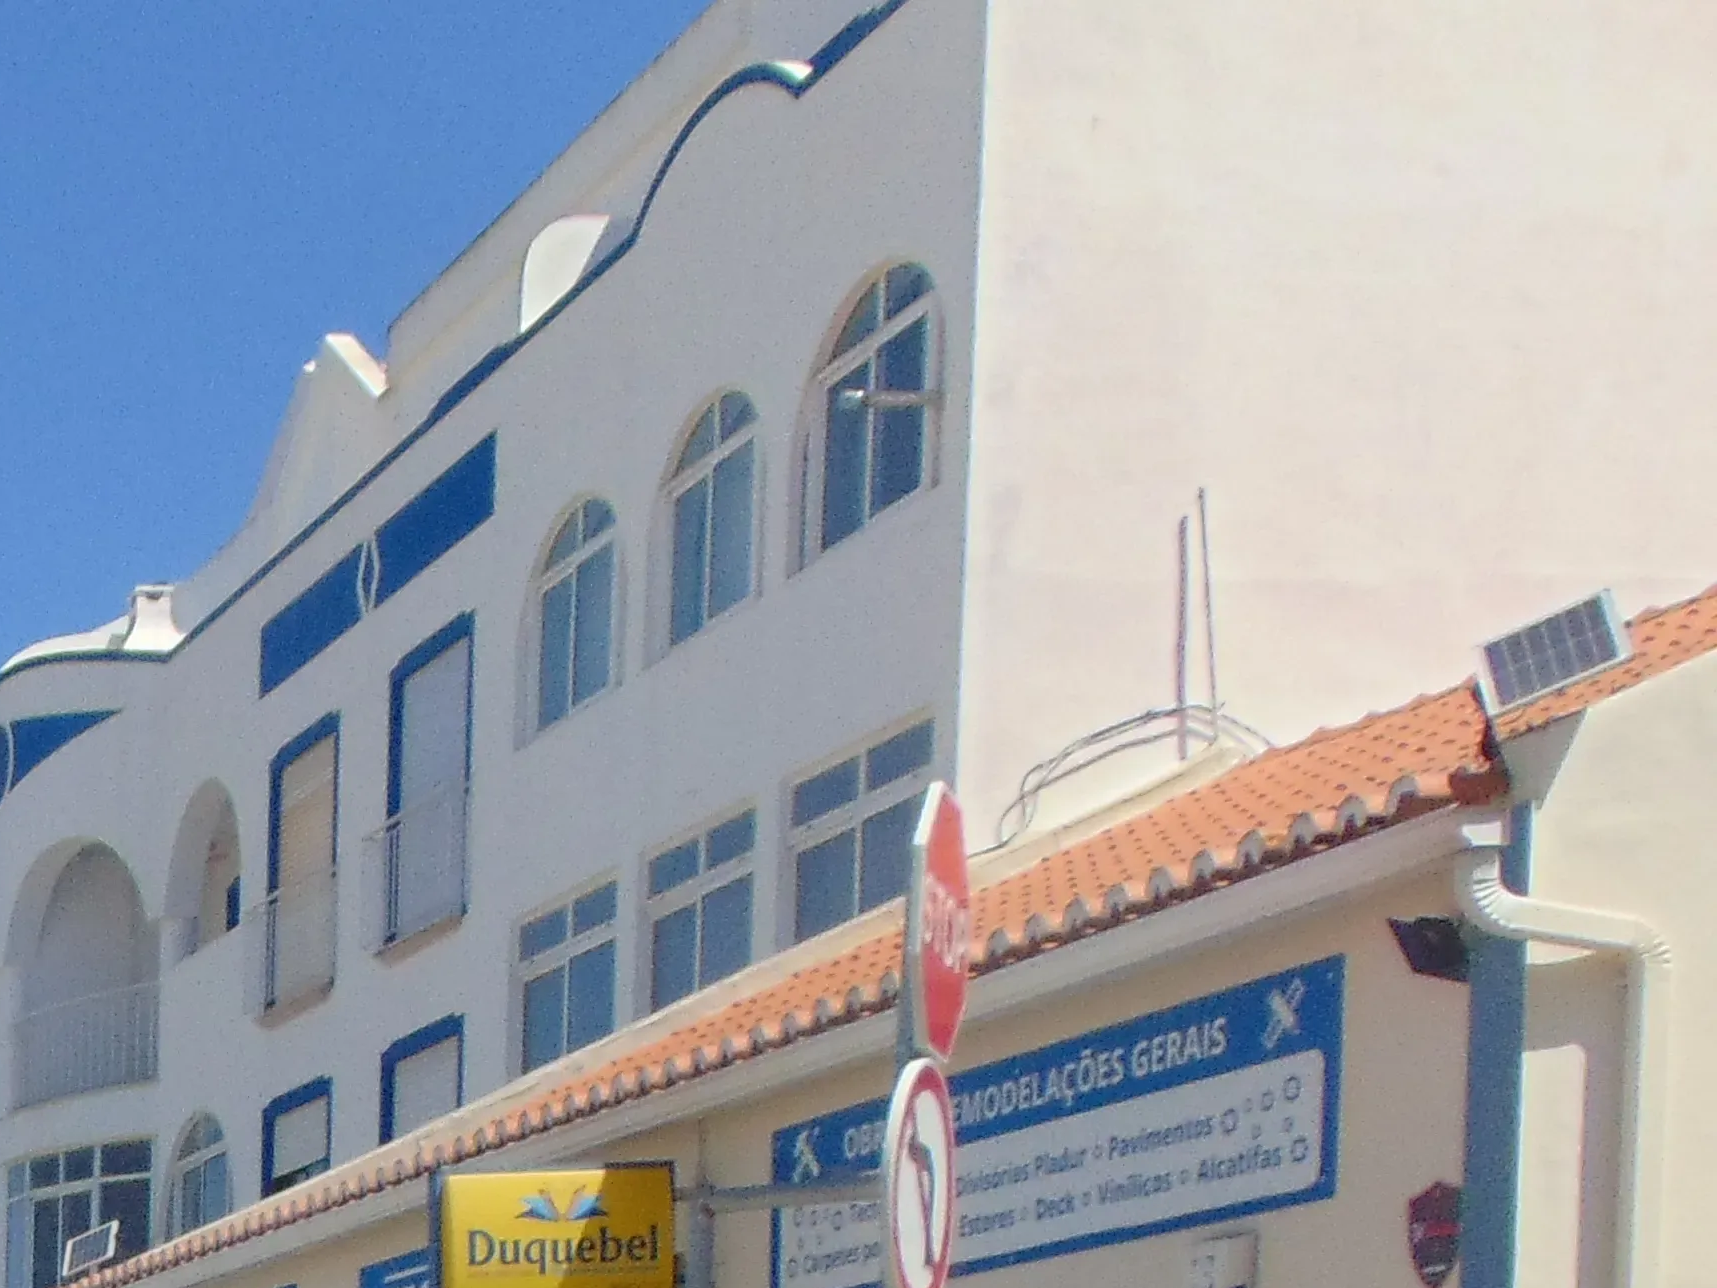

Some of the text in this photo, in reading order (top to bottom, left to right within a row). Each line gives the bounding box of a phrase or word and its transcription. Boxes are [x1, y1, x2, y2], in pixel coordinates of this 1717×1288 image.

[844, 1016, 1228, 1160] OBR EMODELAÇÕES GERAIS
[1108, 1114, 1214, 1161] Pavimentos
[1034, 1190, 1077, 1221] Deck
[1197, 1145, 1283, 1185] Alcatifas
[467, 1222, 660, 1275] Duquebel
